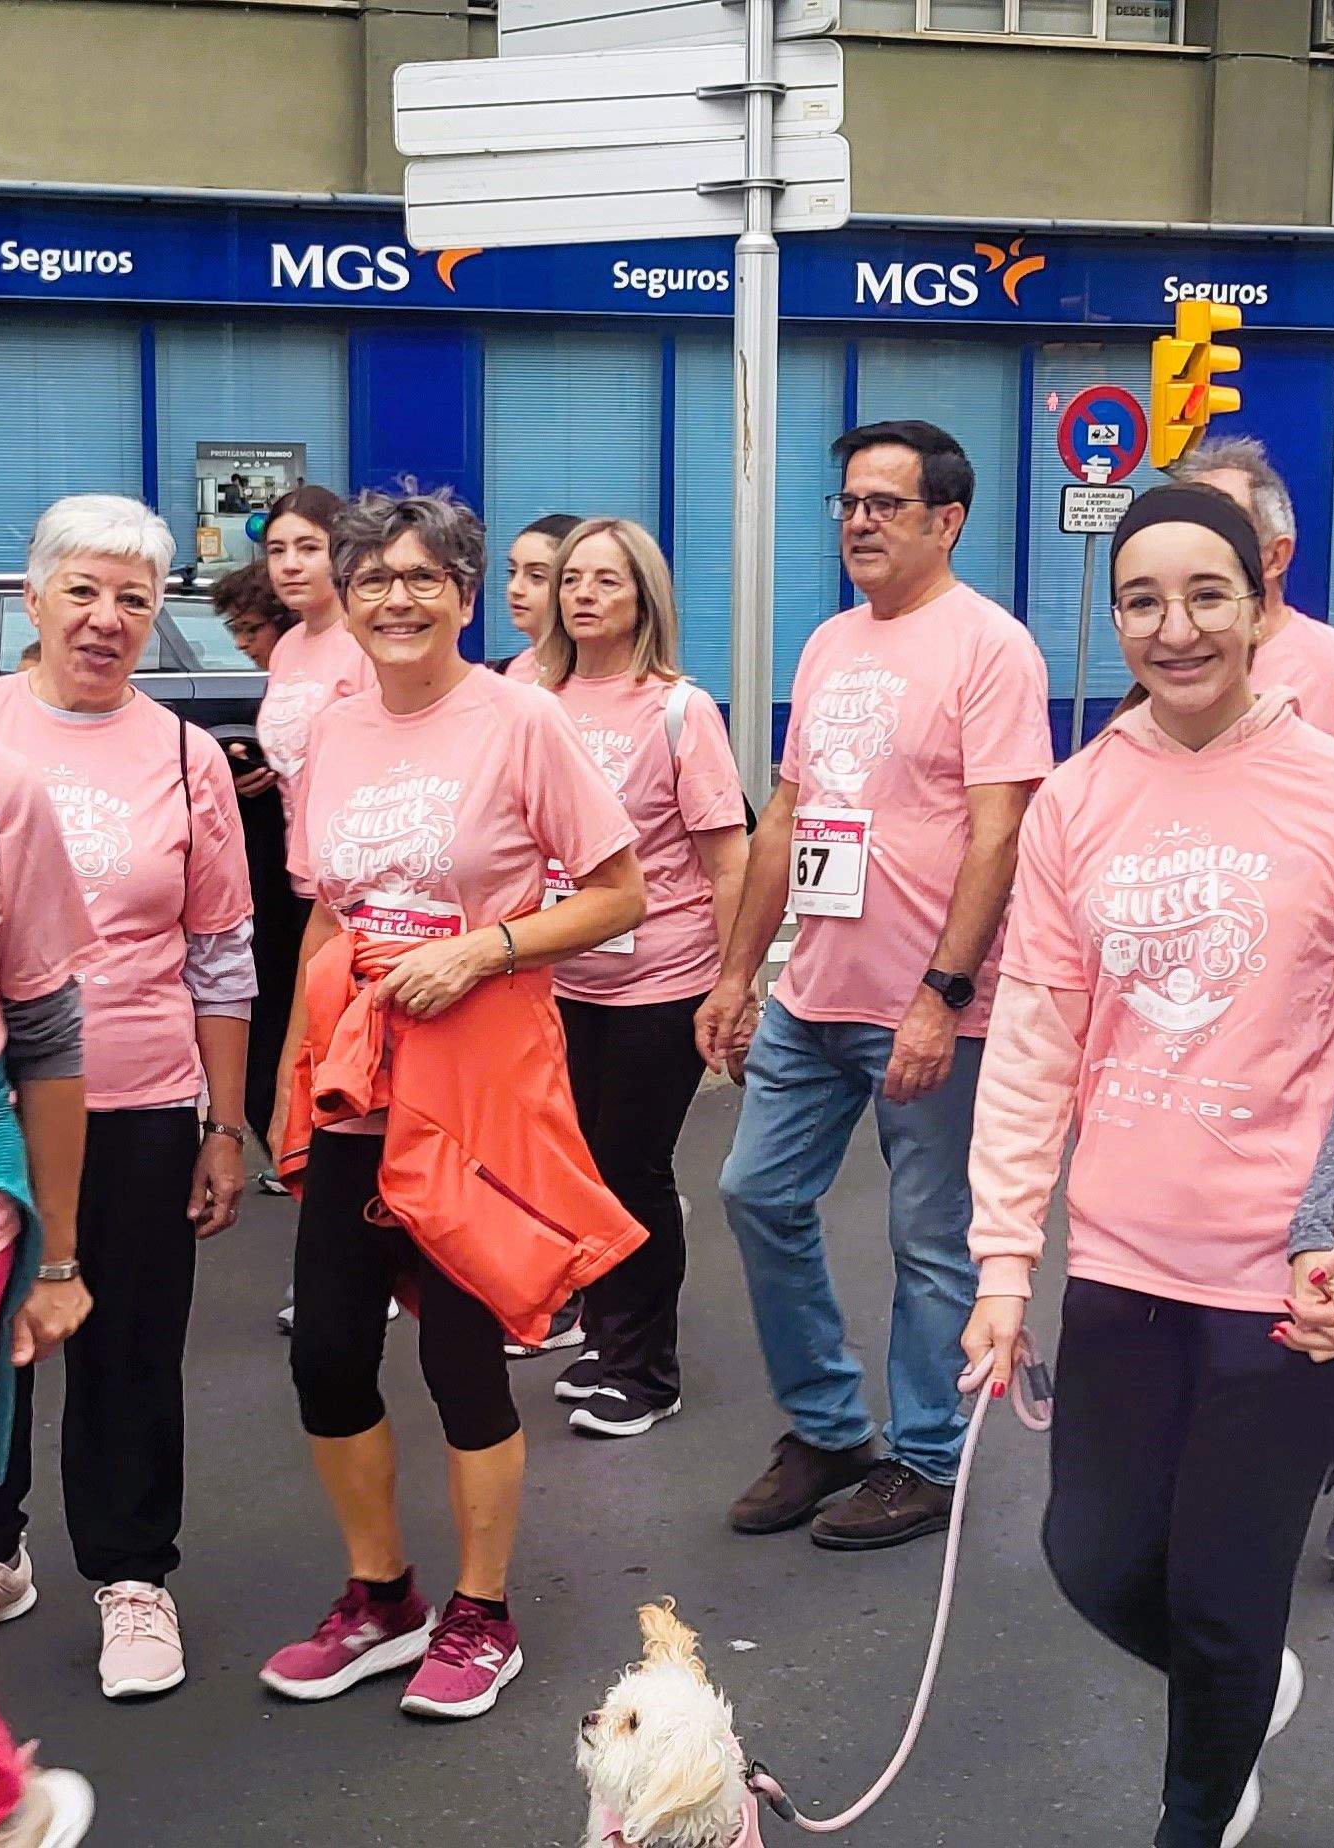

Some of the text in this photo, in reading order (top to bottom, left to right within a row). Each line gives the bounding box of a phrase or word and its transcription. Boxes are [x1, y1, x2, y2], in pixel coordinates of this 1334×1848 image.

[0, 239, 134, 282] Seguros
[270, 243, 730, 298] MGS Seguros
[854, 262, 1269, 307] MGS Seguros
[796, 846, 830, 887] 67
[1112, 873, 1219, 925] HUESCA
[395, 919, 453, 938] CÁNCER
